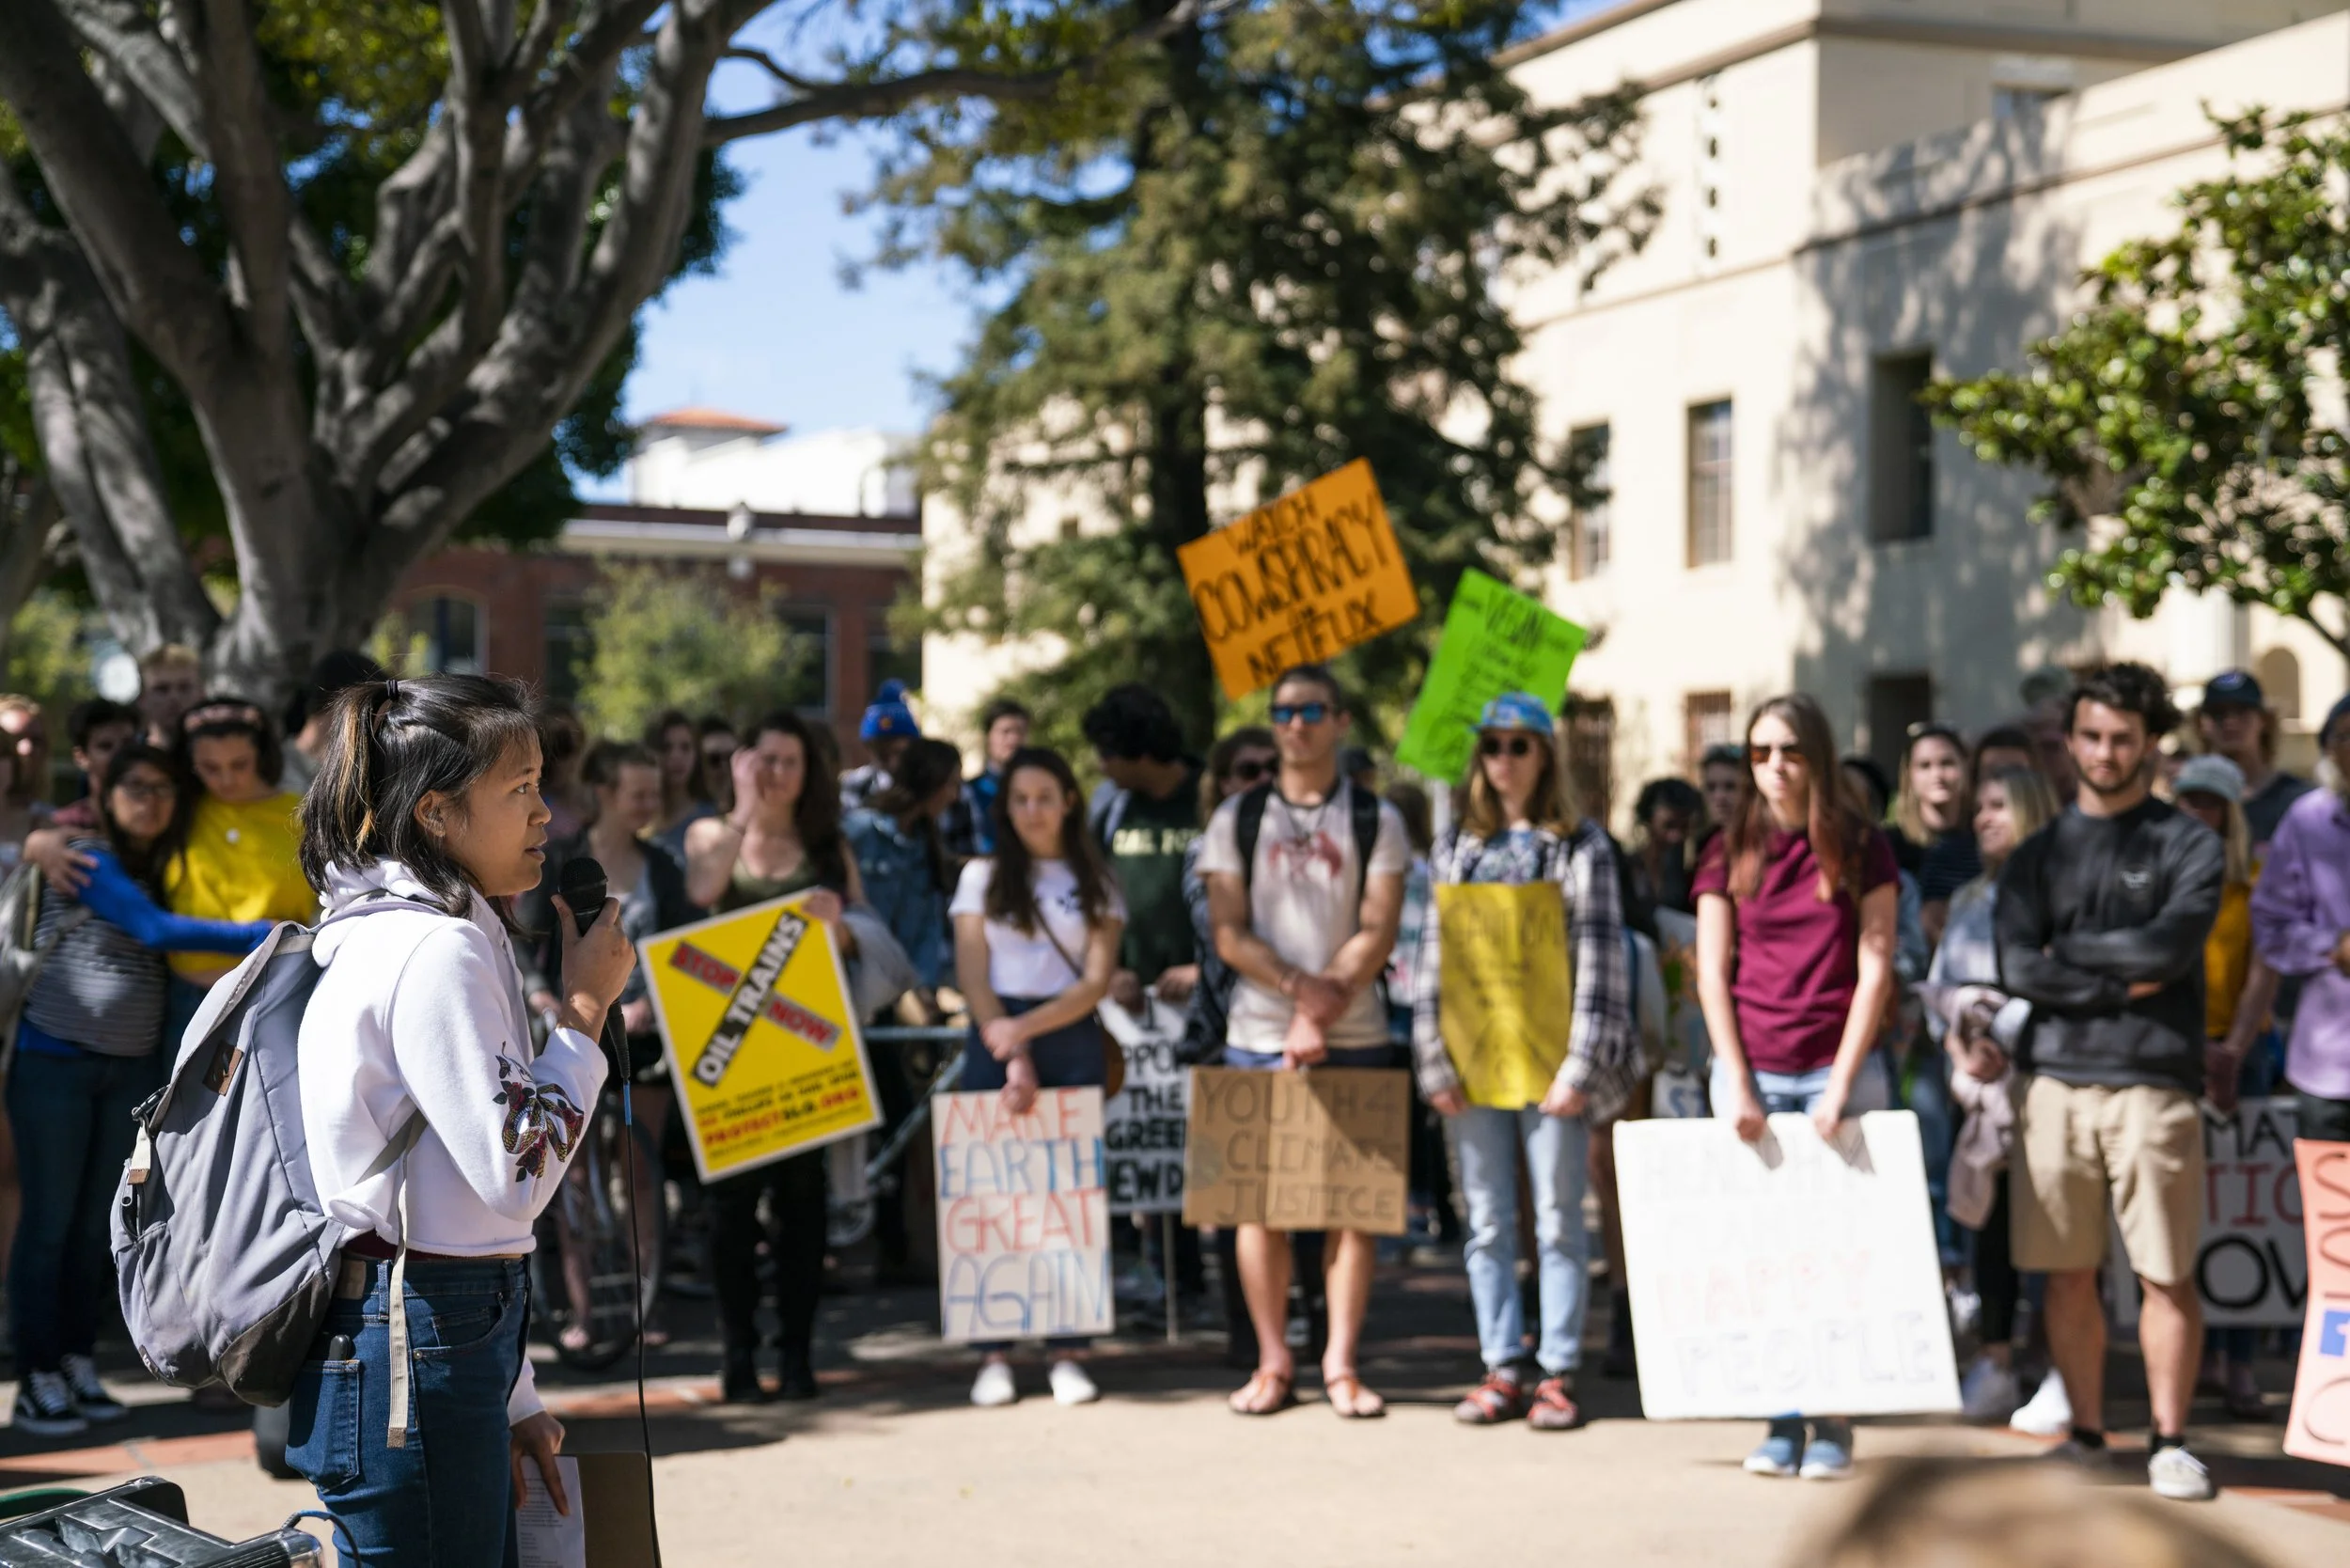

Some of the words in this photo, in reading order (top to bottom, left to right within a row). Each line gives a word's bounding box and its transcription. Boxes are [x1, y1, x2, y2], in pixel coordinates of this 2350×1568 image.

[1225, 489, 1319, 555] WATCH
[1246, 587, 1383, 688] NETFLIX
[673, 942, 742, 990] STOP
[694, 1029, 741, 1084] OIL
[727, 913, 807, 1027] TRAINS
[767, 996, 833, 1044] NOW
[1125, 1083, 1184, 1113] THE
[1196, 1074, 1359, 1126] YOUTH
[941, 1137, 1105, 1198] EARTH
[1226, 1129, 1402, 1174] CLIMATE
[946, 1188, 1108, 1253] GREAT
[1217, 1178, 1398, 1222] JUSTICE
[941, 1247, 1112, 1339] AGAIN
[1673, 1309, 1936, 1398] PEOPLE
